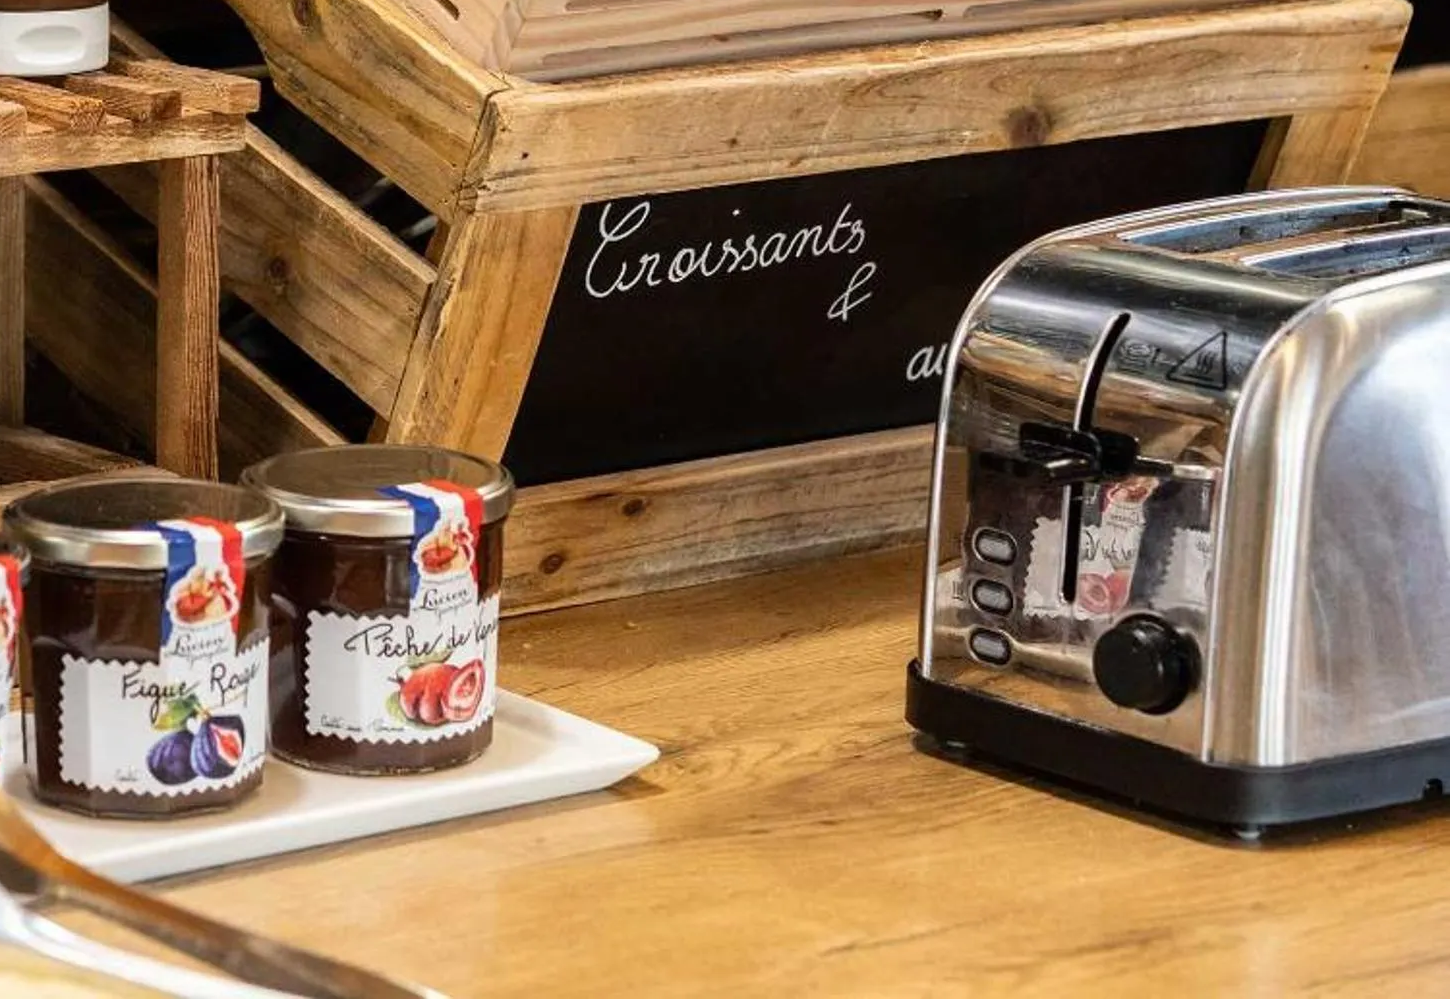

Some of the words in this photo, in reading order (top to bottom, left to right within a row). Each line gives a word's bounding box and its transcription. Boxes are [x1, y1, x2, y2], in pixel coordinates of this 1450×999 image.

[585, 201, 866, 299] Croissants
[827, 261, 878, 322] &
[344, 622, 443, 657] Pêche
[447, 625, 472, 651] de
[122, 668, 201, 724] Figue
